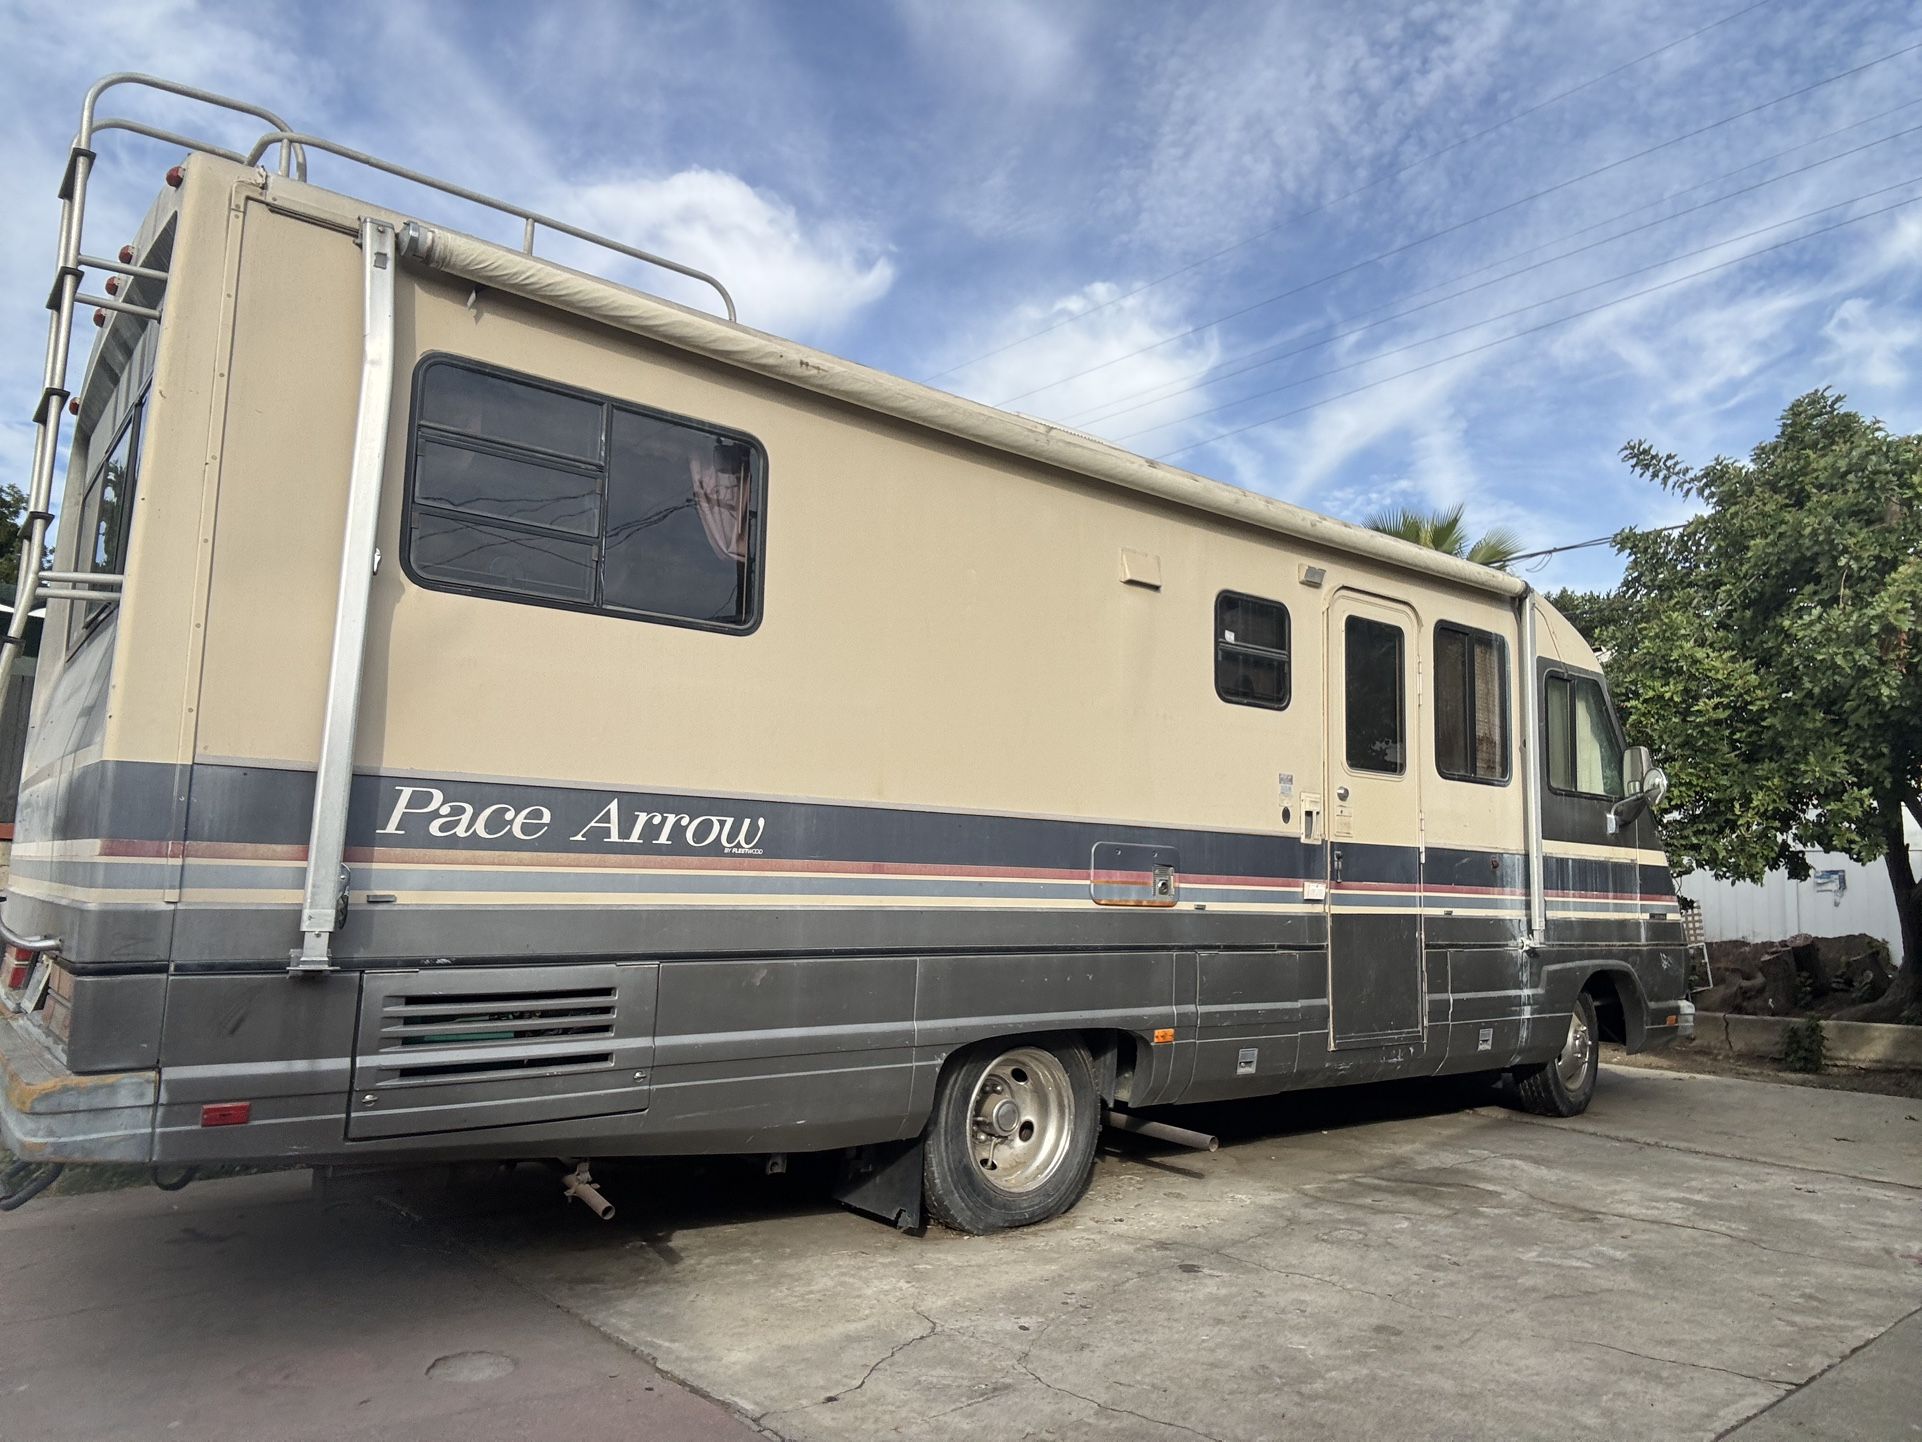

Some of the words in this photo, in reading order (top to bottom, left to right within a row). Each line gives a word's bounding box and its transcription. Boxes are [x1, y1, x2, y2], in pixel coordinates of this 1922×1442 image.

[375, 786, 551, 840] Pace
[569, 797, 765, 849] Arrow
[732, 847, 763, 855] FLEETWOOD
